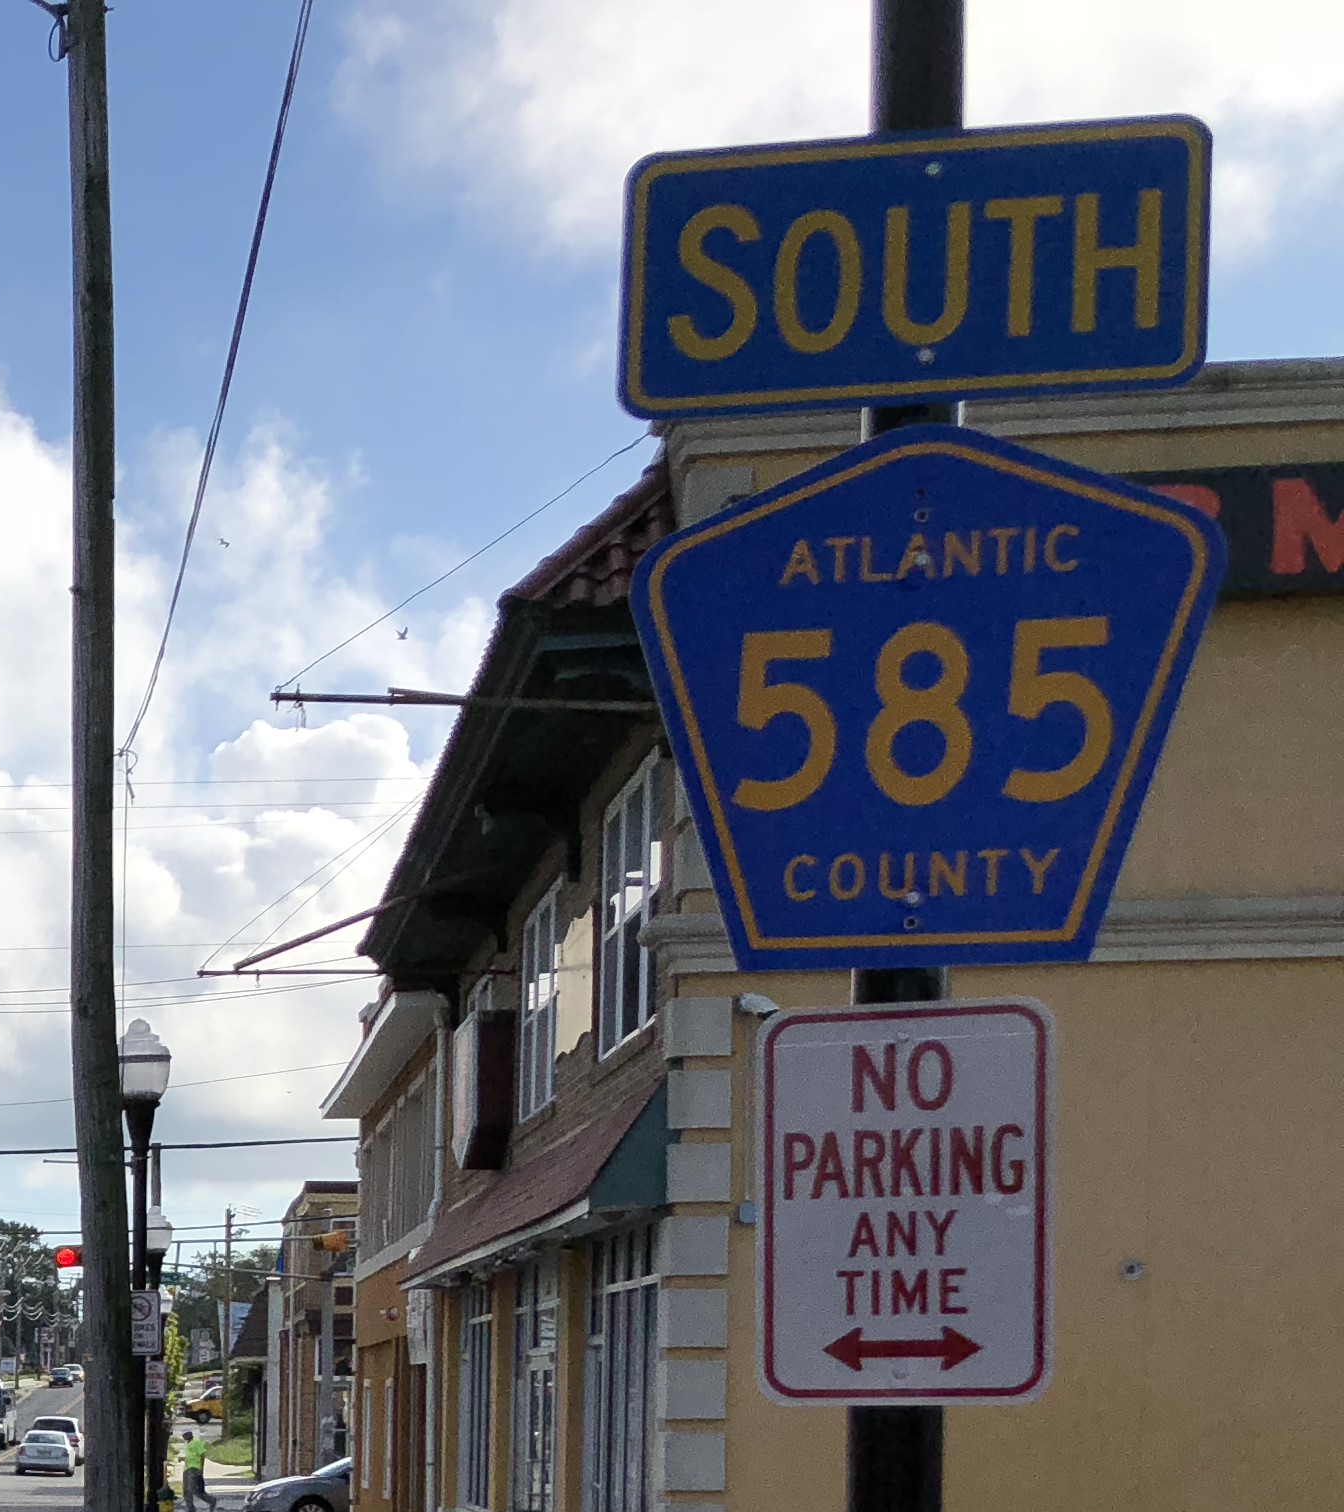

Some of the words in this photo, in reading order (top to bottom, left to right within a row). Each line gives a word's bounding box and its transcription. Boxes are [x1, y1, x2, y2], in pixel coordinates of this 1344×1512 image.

[667, 188, 1163, 361] SOUTH
[780, 524, 1080, 587] ATLANTIC
[732, 616, 1112, 812] 585
[783, 848, 1061, 902] COUNTY
[851, 1039, 953, 1113] NO
[783, 1123, 1026, 1200] PARKING
[848, 1209, 958, 1258] ANY
[835, 1268, 968, 1316] TIME
